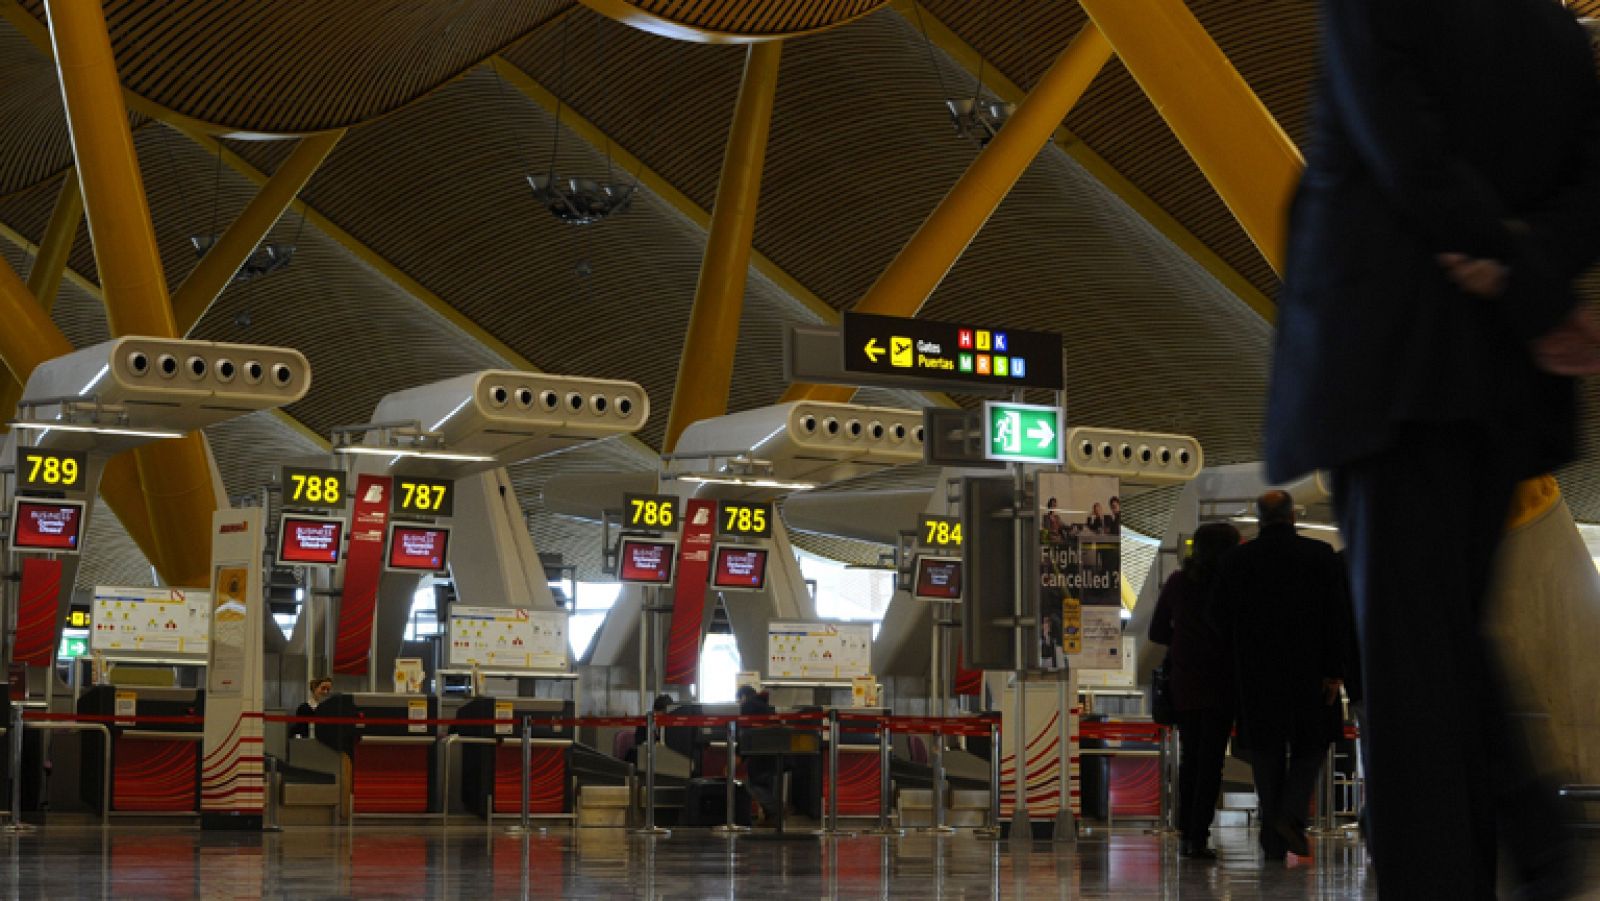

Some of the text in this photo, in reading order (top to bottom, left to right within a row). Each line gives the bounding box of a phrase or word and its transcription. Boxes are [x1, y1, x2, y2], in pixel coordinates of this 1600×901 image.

[918, 354, 955, 370] Puertas
[26, 456, 78, 485] 789
[291, 475, 340, 504] 788
[401, 483, 447, 510] 787
[631, 500, 673, 527] 786
[724, 506, 766, 533] 785
[925, 521, 963, 545] 784
[1041, 546, 1082, 569] Flight
